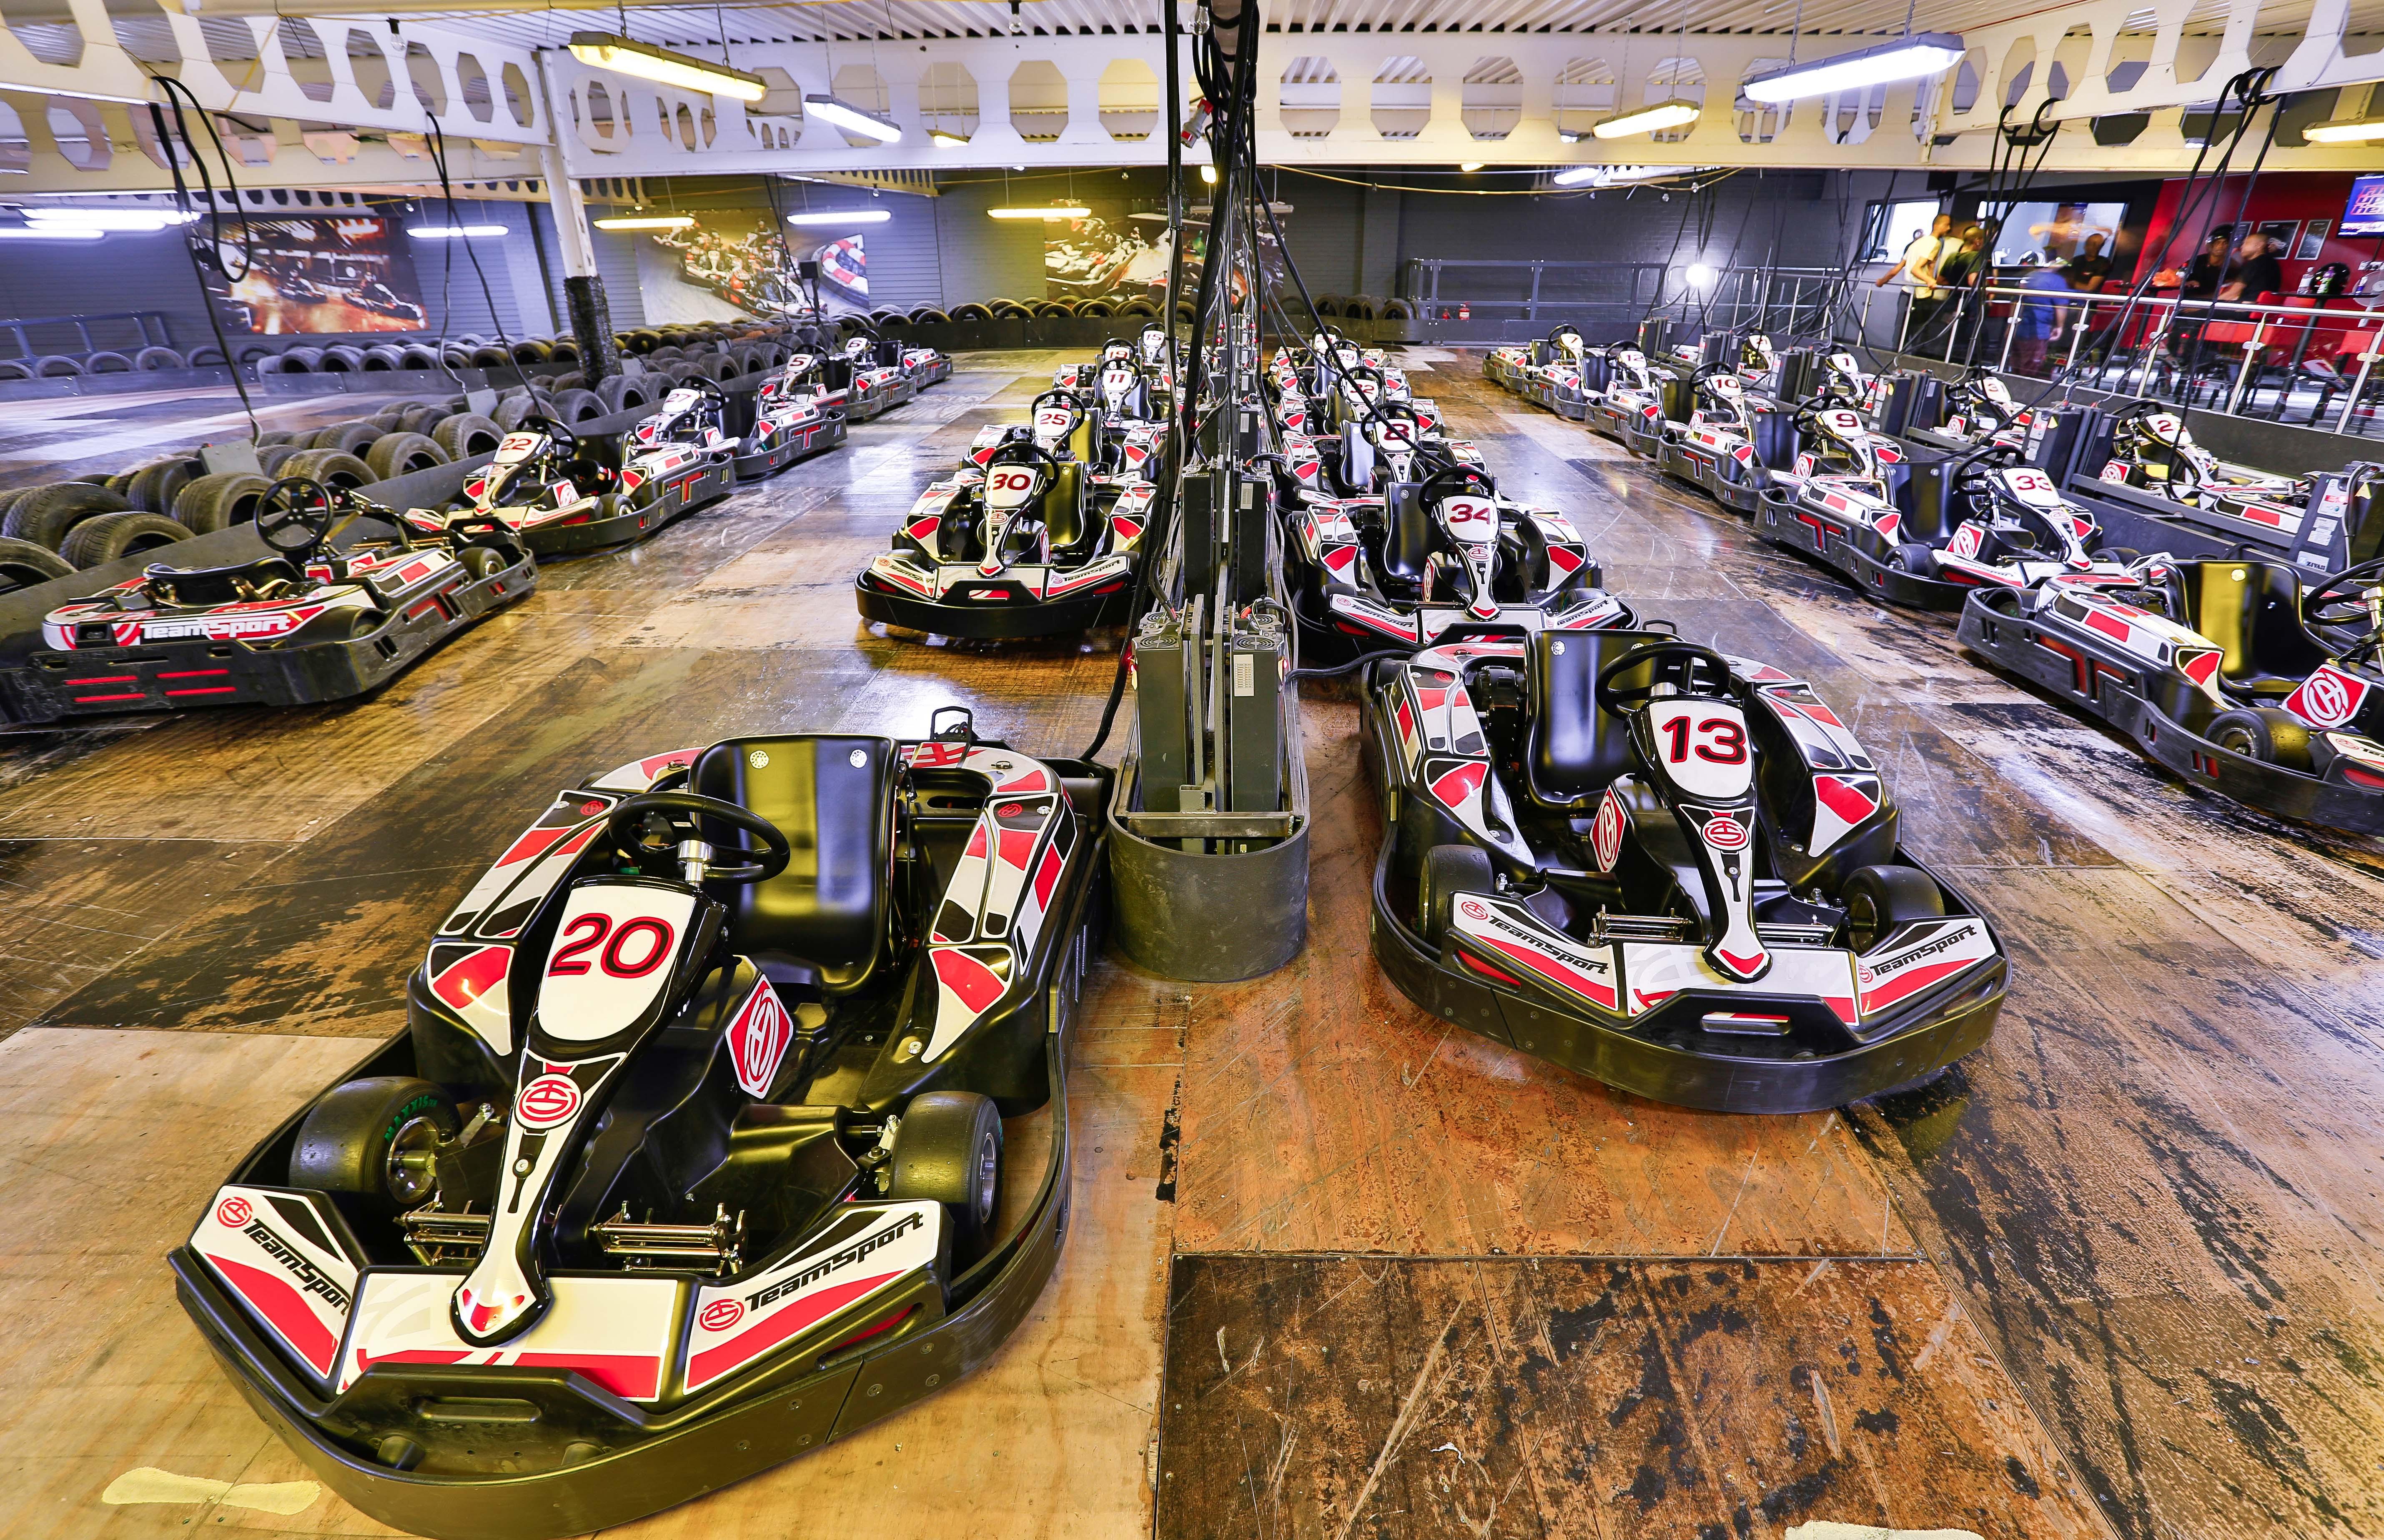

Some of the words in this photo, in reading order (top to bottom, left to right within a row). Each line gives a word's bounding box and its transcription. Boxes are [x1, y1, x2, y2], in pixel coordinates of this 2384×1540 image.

[789, 357, 805, 366] 5
[1110, 351, 1128, 359] 19
[1843, 358, 1850, 366] 1
[1110, 373, 1125, 383] 11
[1715, 378, 1740, 389] 10
[665, 393, 692, 403] 27
[1040, 413, 1068, 426] 25
[1835, 413, 1858, 428] 9
[1384, 423, 1410, 441] 8
[501, 438, 532, 451] 22
[987, 473, 1031, 491] 30
[2015, 475, 2053, 492] 33
[1449, 503, 1496, 525] 34
[1062, 559, 1121, 582] TeamSport
[1351, 604, 1414, 628] TeamSport
[139, 615, 291, 639] TeamSport
[1662, 715, 1747, 765] 13
[547, 912, 674, 979] 20
[1486, 914, 1609, 975] TeamSport
[1869, 924, 1977, 977] TeamSport
[745, 1212, 923, 1312] TeamSport
